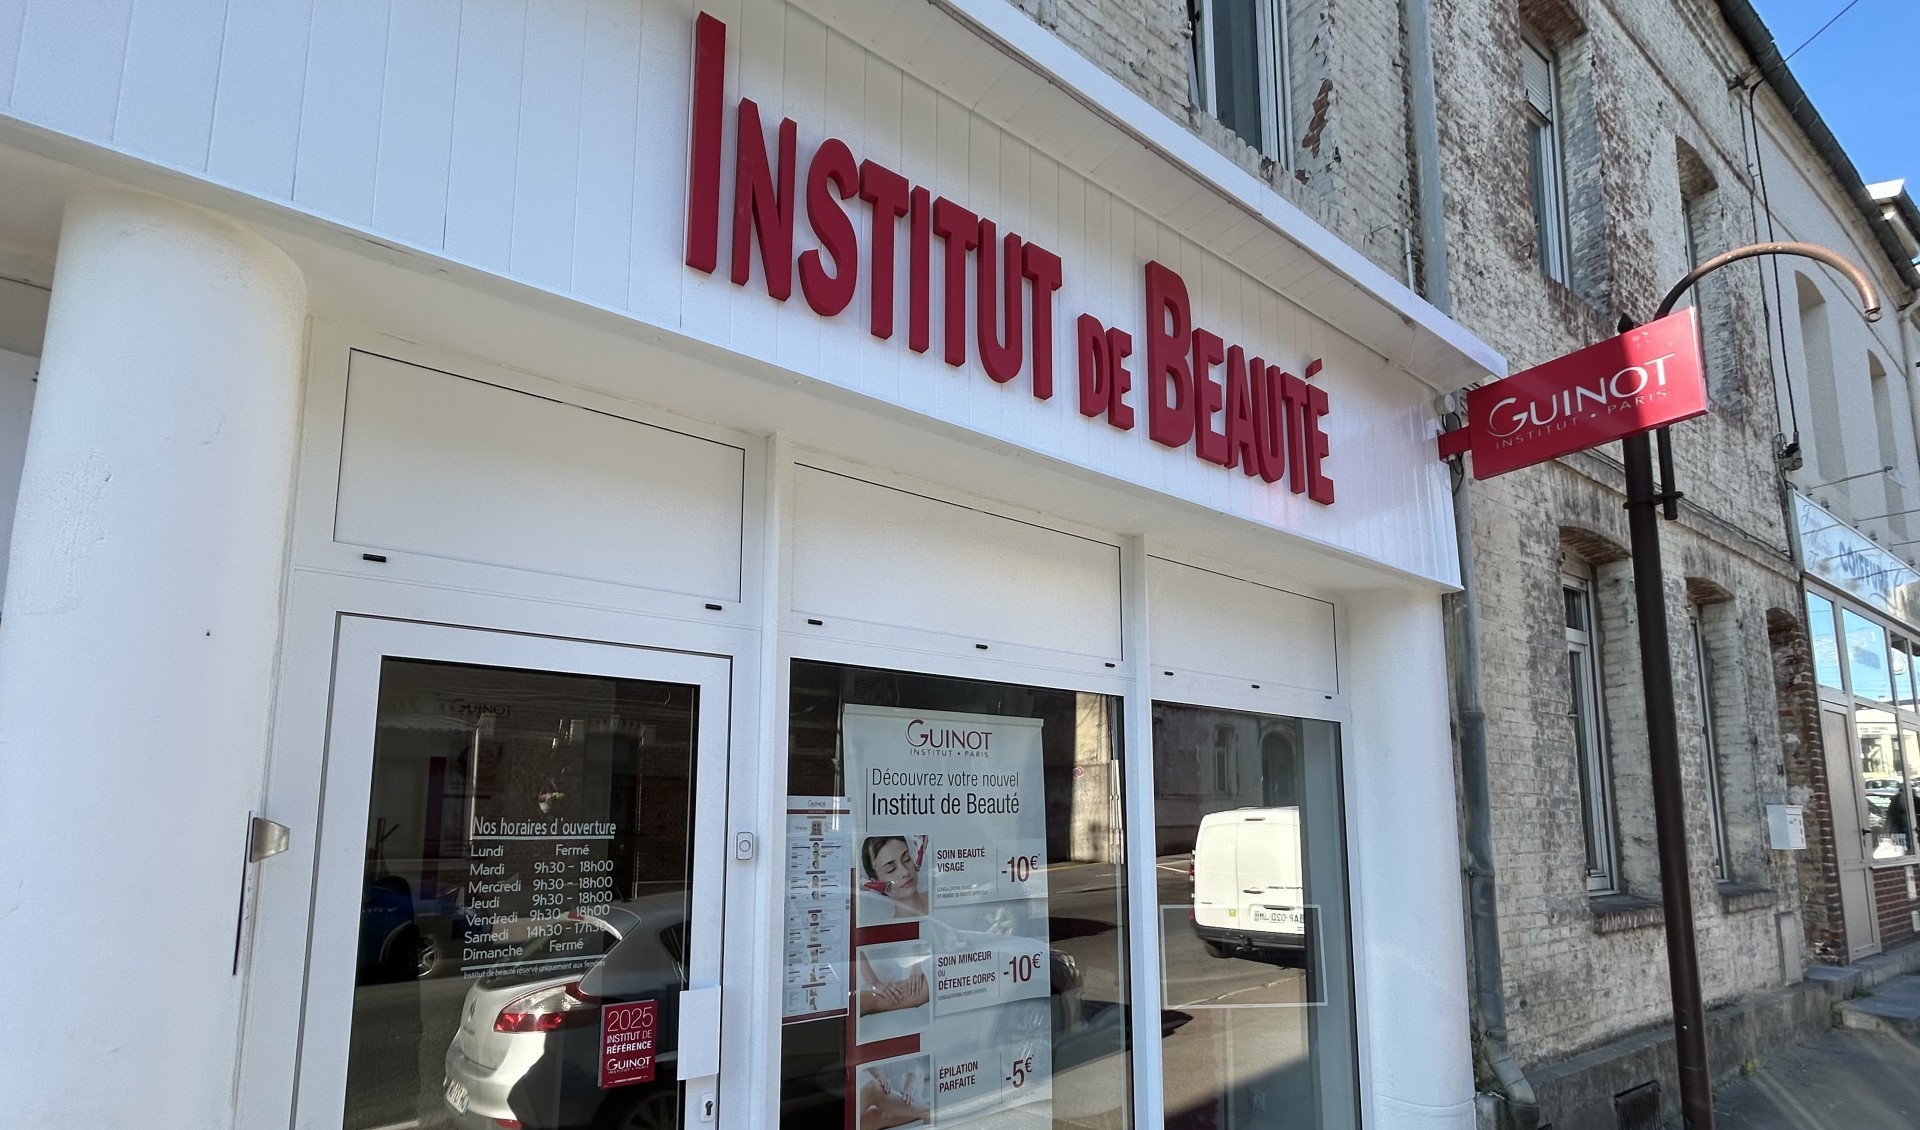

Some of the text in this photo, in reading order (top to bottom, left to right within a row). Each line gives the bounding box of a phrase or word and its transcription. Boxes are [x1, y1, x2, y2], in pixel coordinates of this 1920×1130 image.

[685, 11, 1334, 506] INSTITUT DE BEAUTÉ
[1487, 353, 1675, 437] GUINOT
[1496, 388, 1669, 450] INSTITUT PARIS
[905, 719, 993, 750] GUINOT
[910, 749, 953, 757] INSTITUT
[872, 767, 1019, 788] Découvrez votre nouvel
[872, 792, 1020, 816] Institut de Beauté
[473, 816, 496, 835] Nos
[500, 817, 547, 835] horaires
[471, 843, 590, 857] Lundi Fermé
[937, 845, 986, 860] SOIN BEAUTÉ
[470, 863, 505, 876] Mardi
[534, 861, 565, 874] 9h30
[580, 860, 614, 872] 18h00
[937, 861, 965, 873] VISAGE
[468, 880, 522, 894] Mercredi
[533, 878, 564, 891] 9h30
[579, 876, 613, 889] 18h00
[468, 897, 500, 910] Jeudi
[532, 893, 563, 906] 9h30
[579, 891, 613, 903] 18h00
[466, 904, 610, 927] Vendredi 9h30 18h00
[464, 929, 509, 944] Samedi
[527, 924, 563, 938] 14h30
[463, 939, 584, 961] Dimanche Fermé
[938, 950, 992, 967] SOIN MINCEUR
[486, 969, 495, 977] de
[539, 963, 572, 973] uniquement
[938, 972, 996, 991] DÉTENTE CORPS
[608, 1006, 654, 1032] 2025
[606, 1029, 653, 1044] INSTITUT DE
[606, 1040, 652, 1055] RÉFÉRENCE
[606, 1056, 651, 1071] GUINOT
[940, 1060, 978, 1079] ÉPILATION
[940, 1075, 976, 1093] PARFAITE
